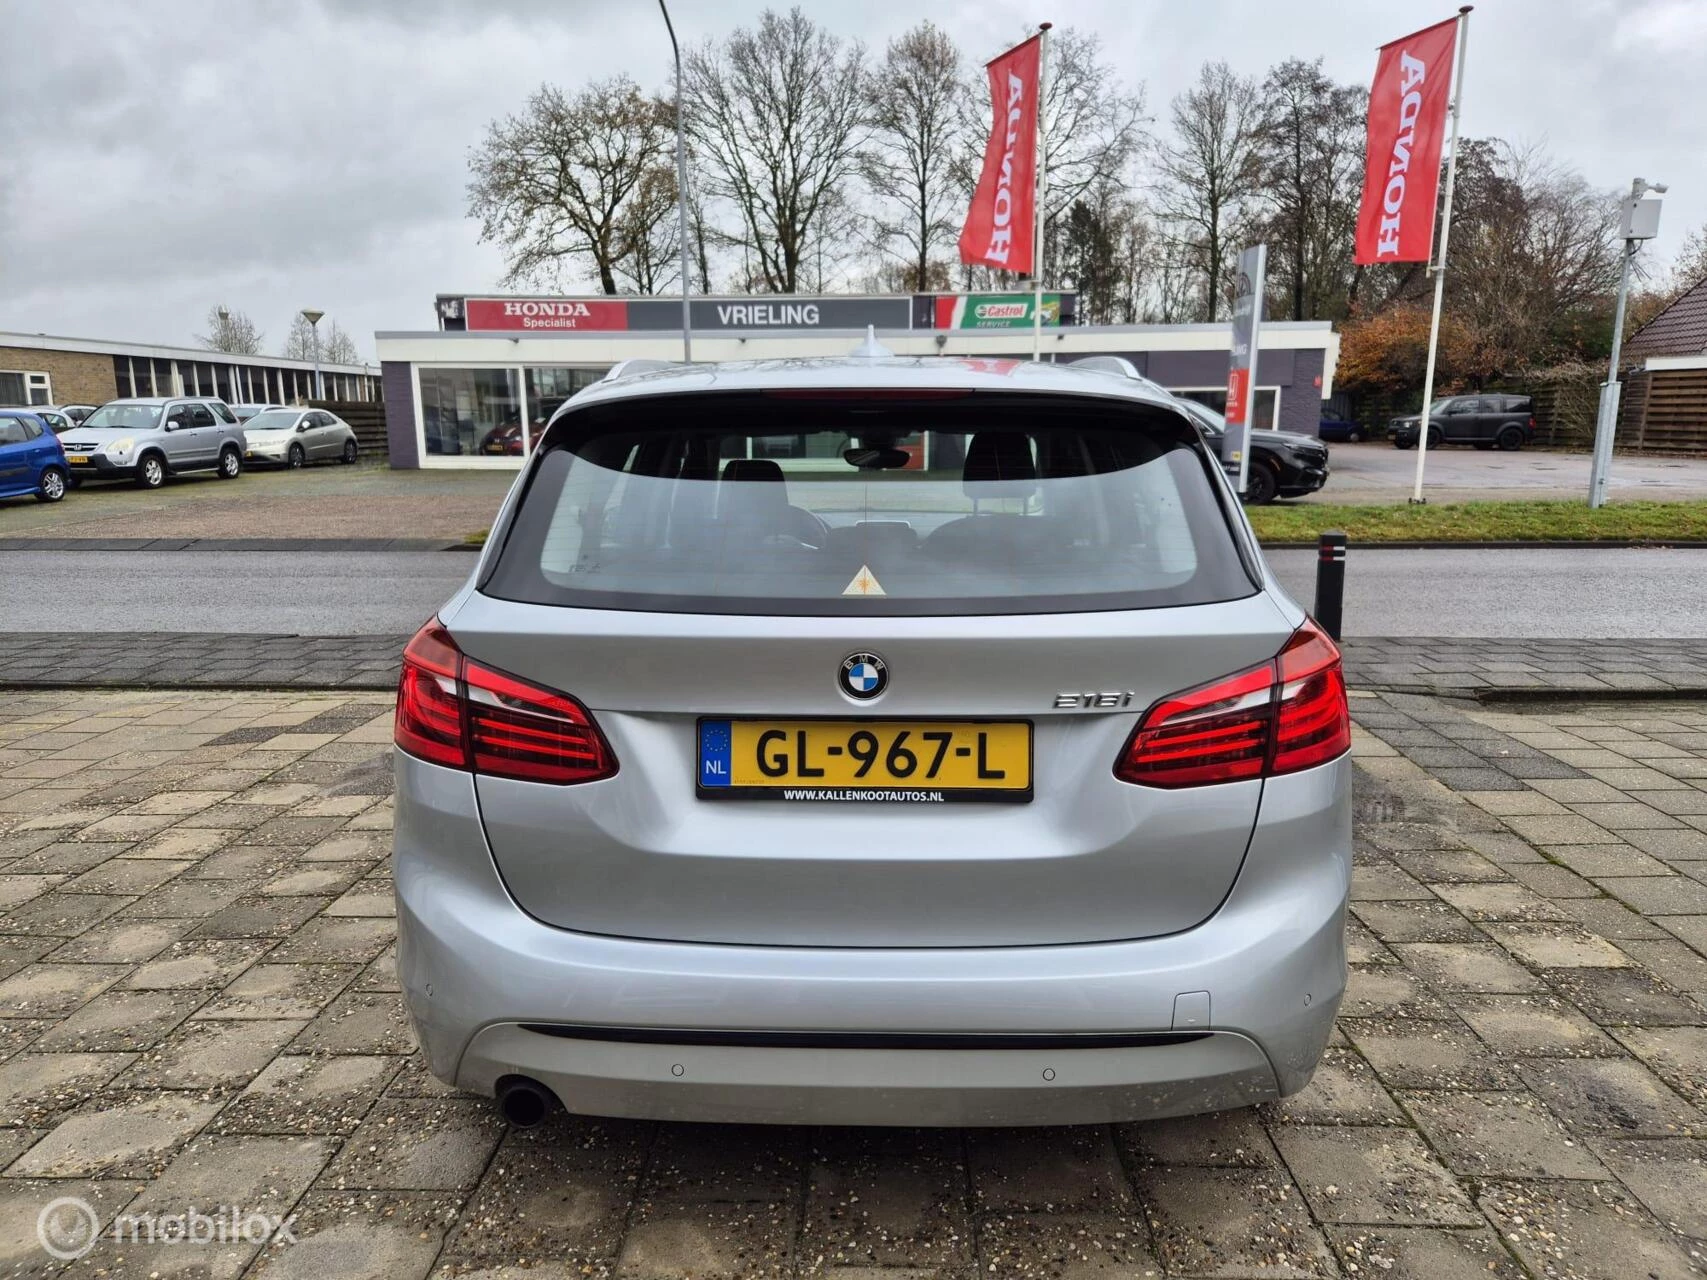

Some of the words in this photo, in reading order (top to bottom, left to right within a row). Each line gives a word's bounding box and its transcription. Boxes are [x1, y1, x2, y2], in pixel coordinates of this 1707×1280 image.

[1377, 50, 1426, 258] HONDA
[504, 302, 590, 317] HONDA
[717, 304, 819, 327] VRIELING
[988, 304, 1024, 317] Castrol
[523, 316, 577, 329] Specialist
[844, 655, 884, 671] BMW
[1052, 691, 1135, 709] 218i
[756, 729, 1006, 779] GL-967-L
[705, 759, 727, 775] NL
[783, 789, 945, 803] WWW.KALLENKOOTAUTOS.NL
